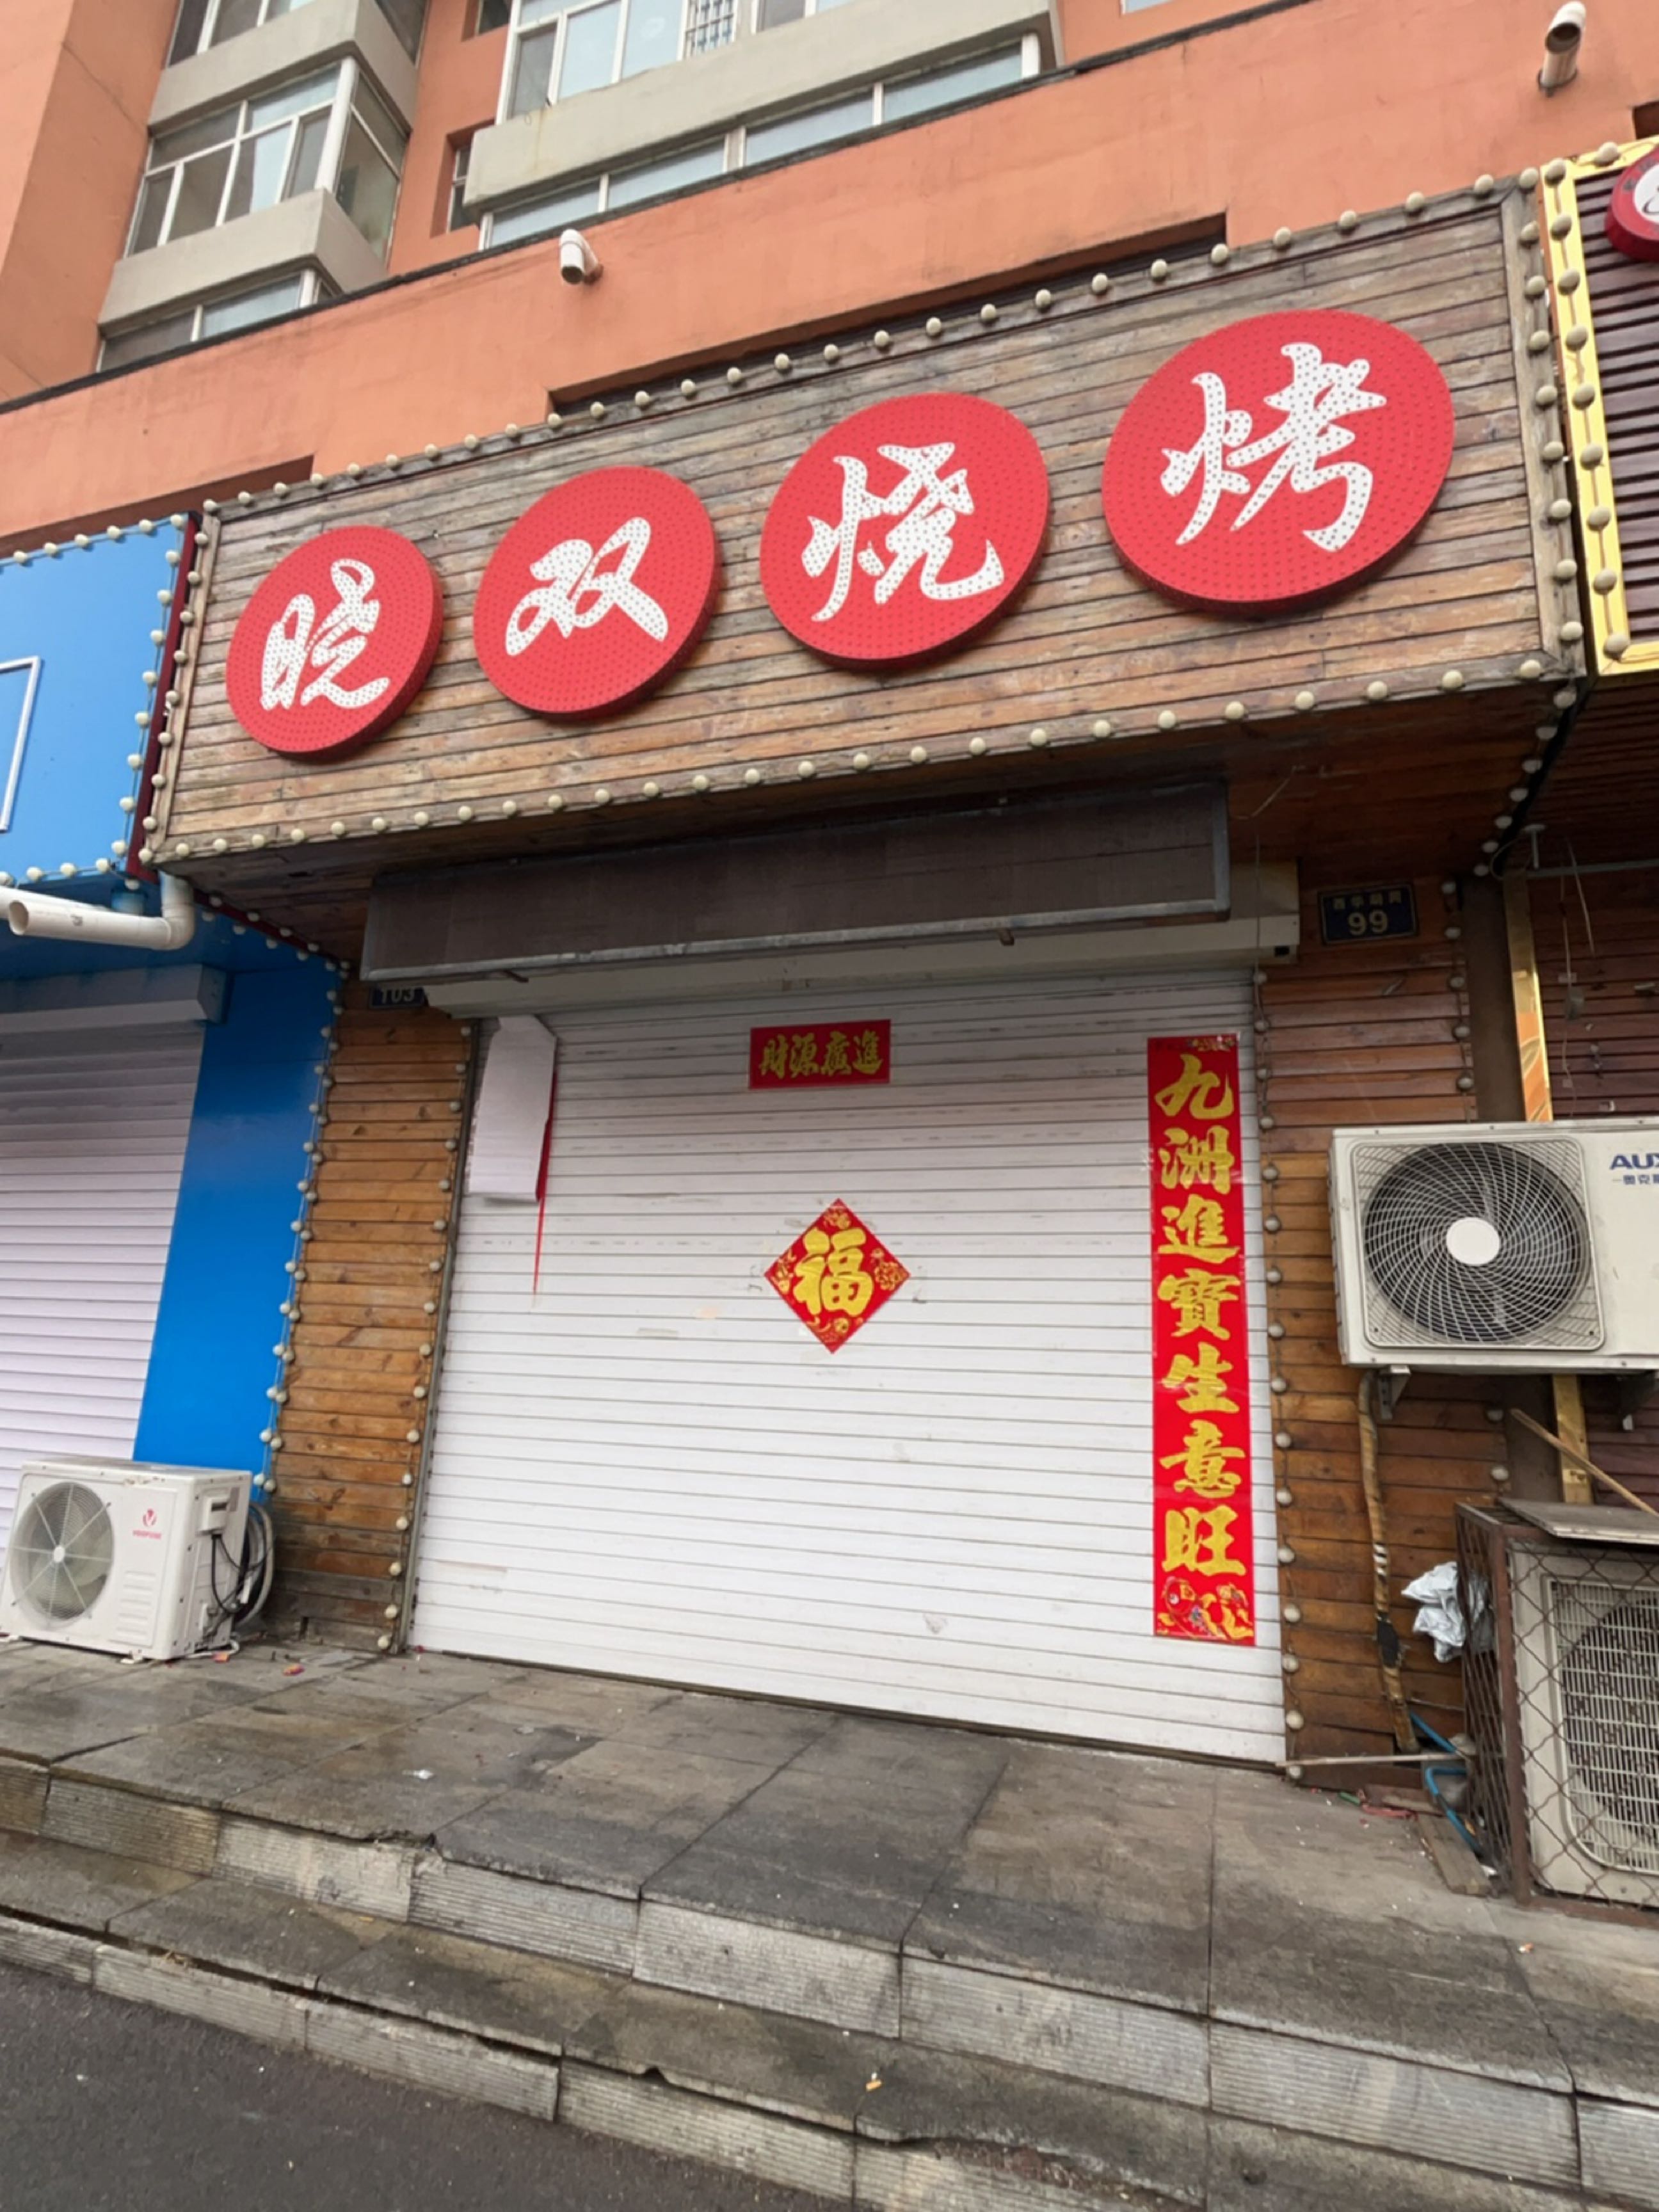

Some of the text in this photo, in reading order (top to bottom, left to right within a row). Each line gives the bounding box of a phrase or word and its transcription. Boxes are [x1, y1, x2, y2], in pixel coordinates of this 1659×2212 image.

[1347, 910, 1388, 936] 99
[792, 1227, 874, 1317] 福
[1155, 1053, 1247, 1577] 九洲進寶生意旺
